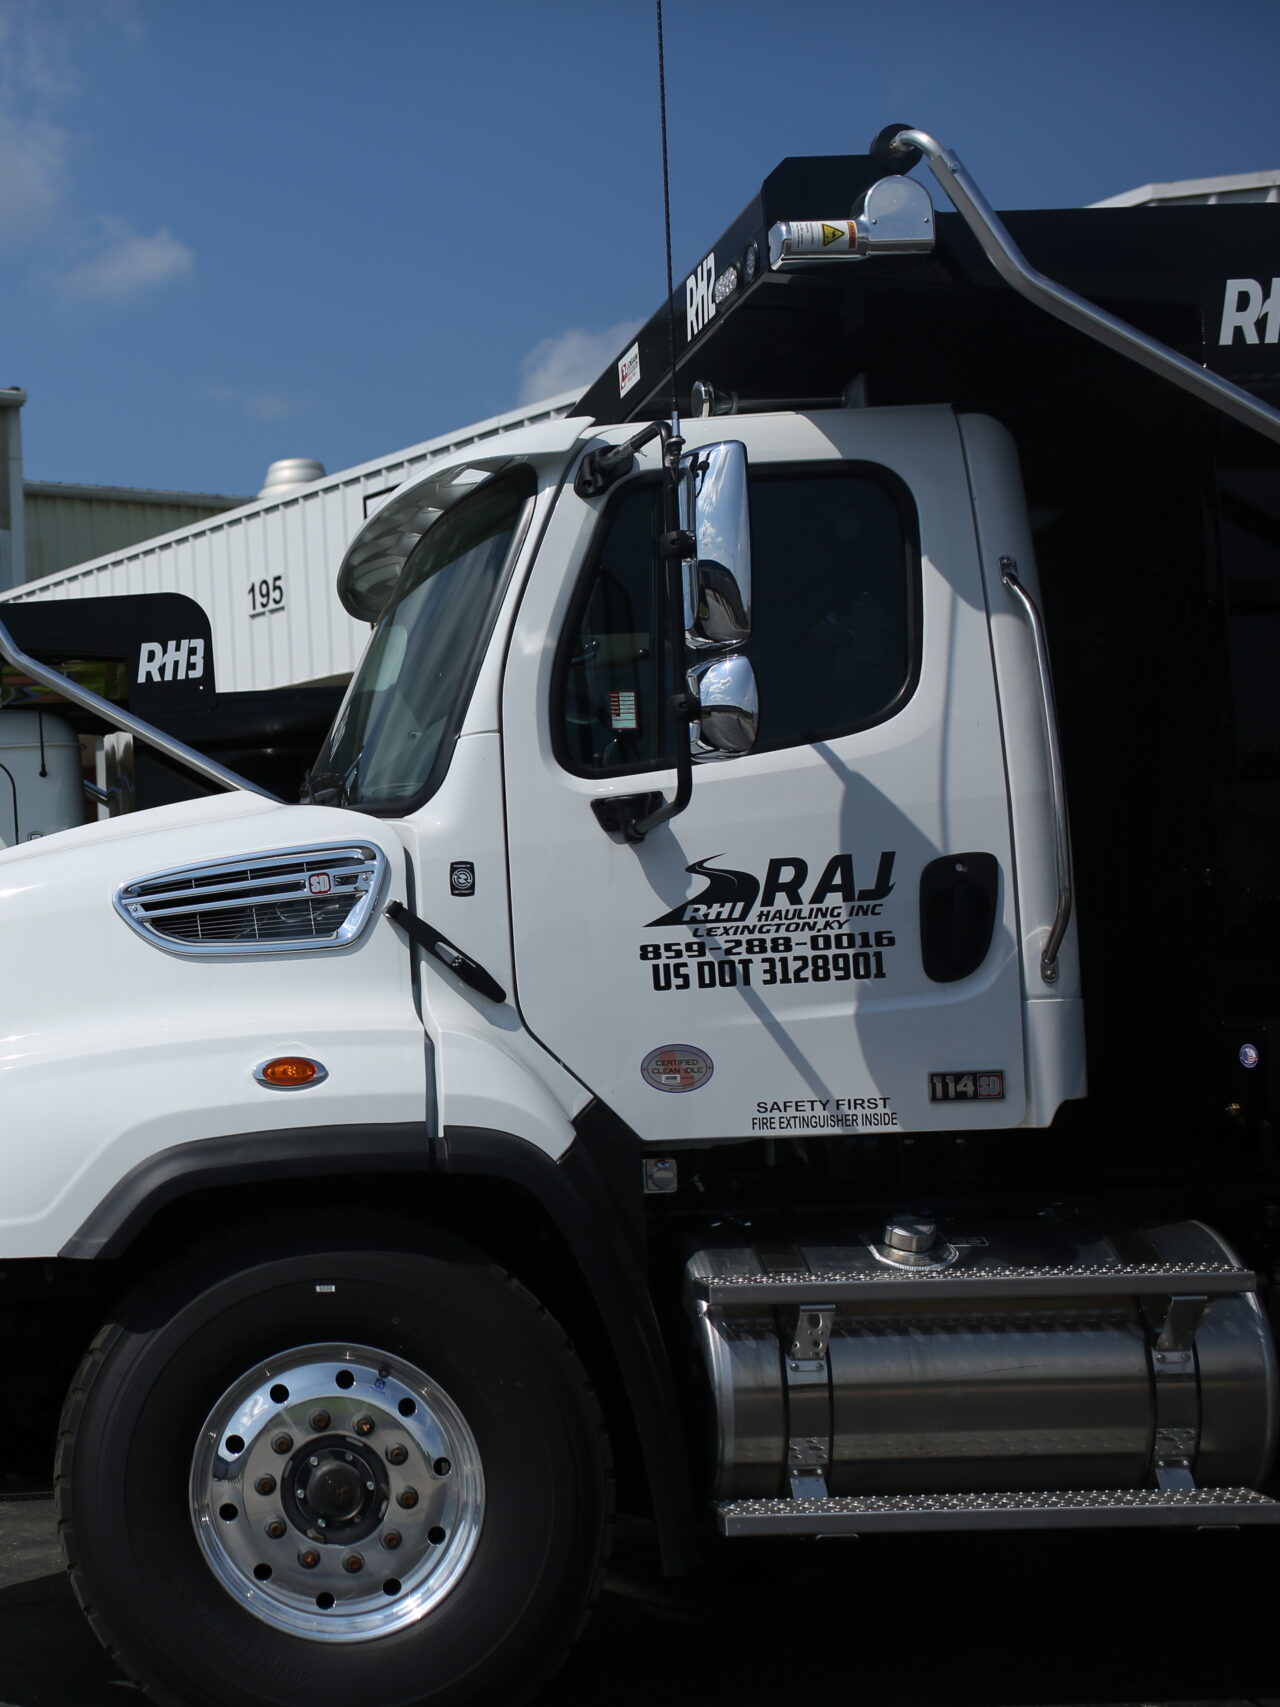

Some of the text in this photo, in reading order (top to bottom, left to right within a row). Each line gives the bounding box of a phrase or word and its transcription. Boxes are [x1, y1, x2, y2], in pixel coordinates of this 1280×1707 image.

[686, 252, 717, 343] RH2
[248, 575, 284, 611] 195
[137, 638, 205, 683] RH3
[760, 851, 896, 908] RAJ
[681, 902, 746, 922] RHI
[756, 904, 882, 922] HAULING INC
[639, 930, 895, 961] 859-288-0016
[652, 951, 887, 991] US DOT 3128901
[651, 1066, 703, 1075] CLEAN IDLE
[655, 1059, 699, 1067] CERTIFIED
[756, 1097, 891, 1113] SAFETY FIRST
[752, 1112, 898, 1130] FIRE EXTINGUISHER INSIDE
